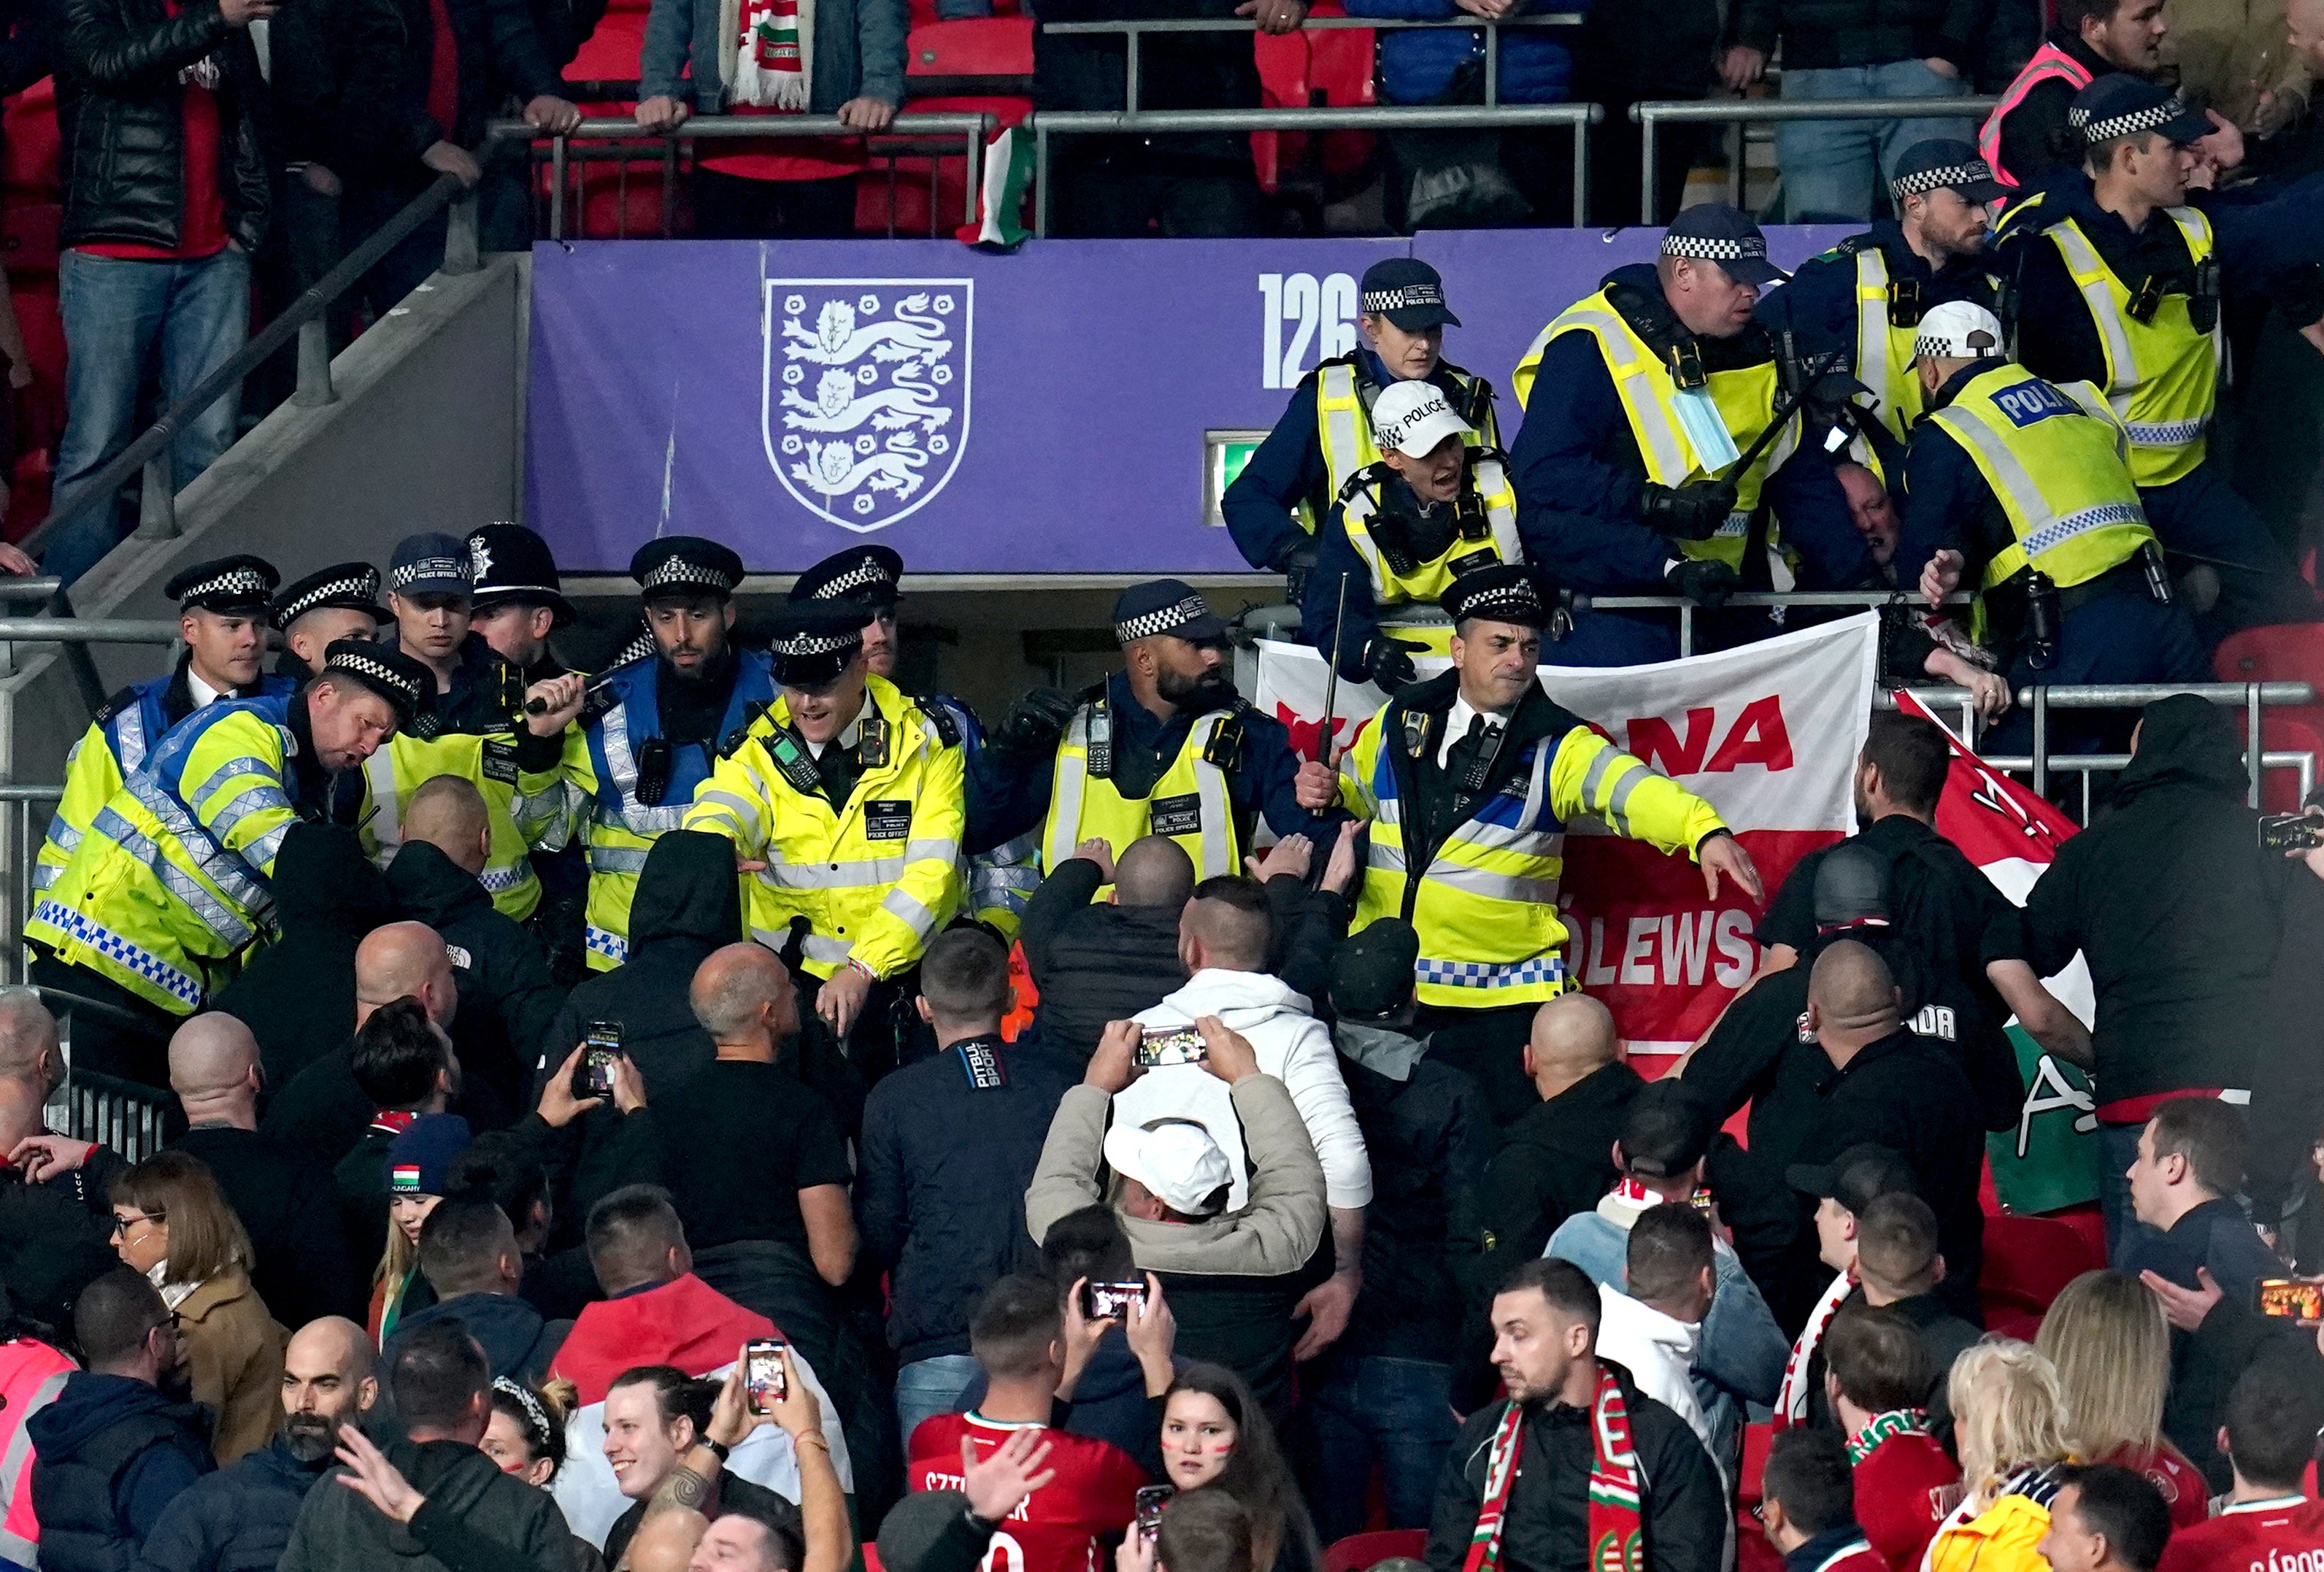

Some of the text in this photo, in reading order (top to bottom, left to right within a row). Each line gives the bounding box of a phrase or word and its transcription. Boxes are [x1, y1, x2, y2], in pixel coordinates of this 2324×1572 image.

[1258, 273, 1357, 389] 126
[1403, 398, 1446, 428] POLICE
[1998, 385, 2077, 420] POLI
[418, 570, 458, 579] POLICE OFFICER
[1155, 822, 1198, 834] POLICE OFFICER
[975, 1042, 1001, 1087] SPORT
